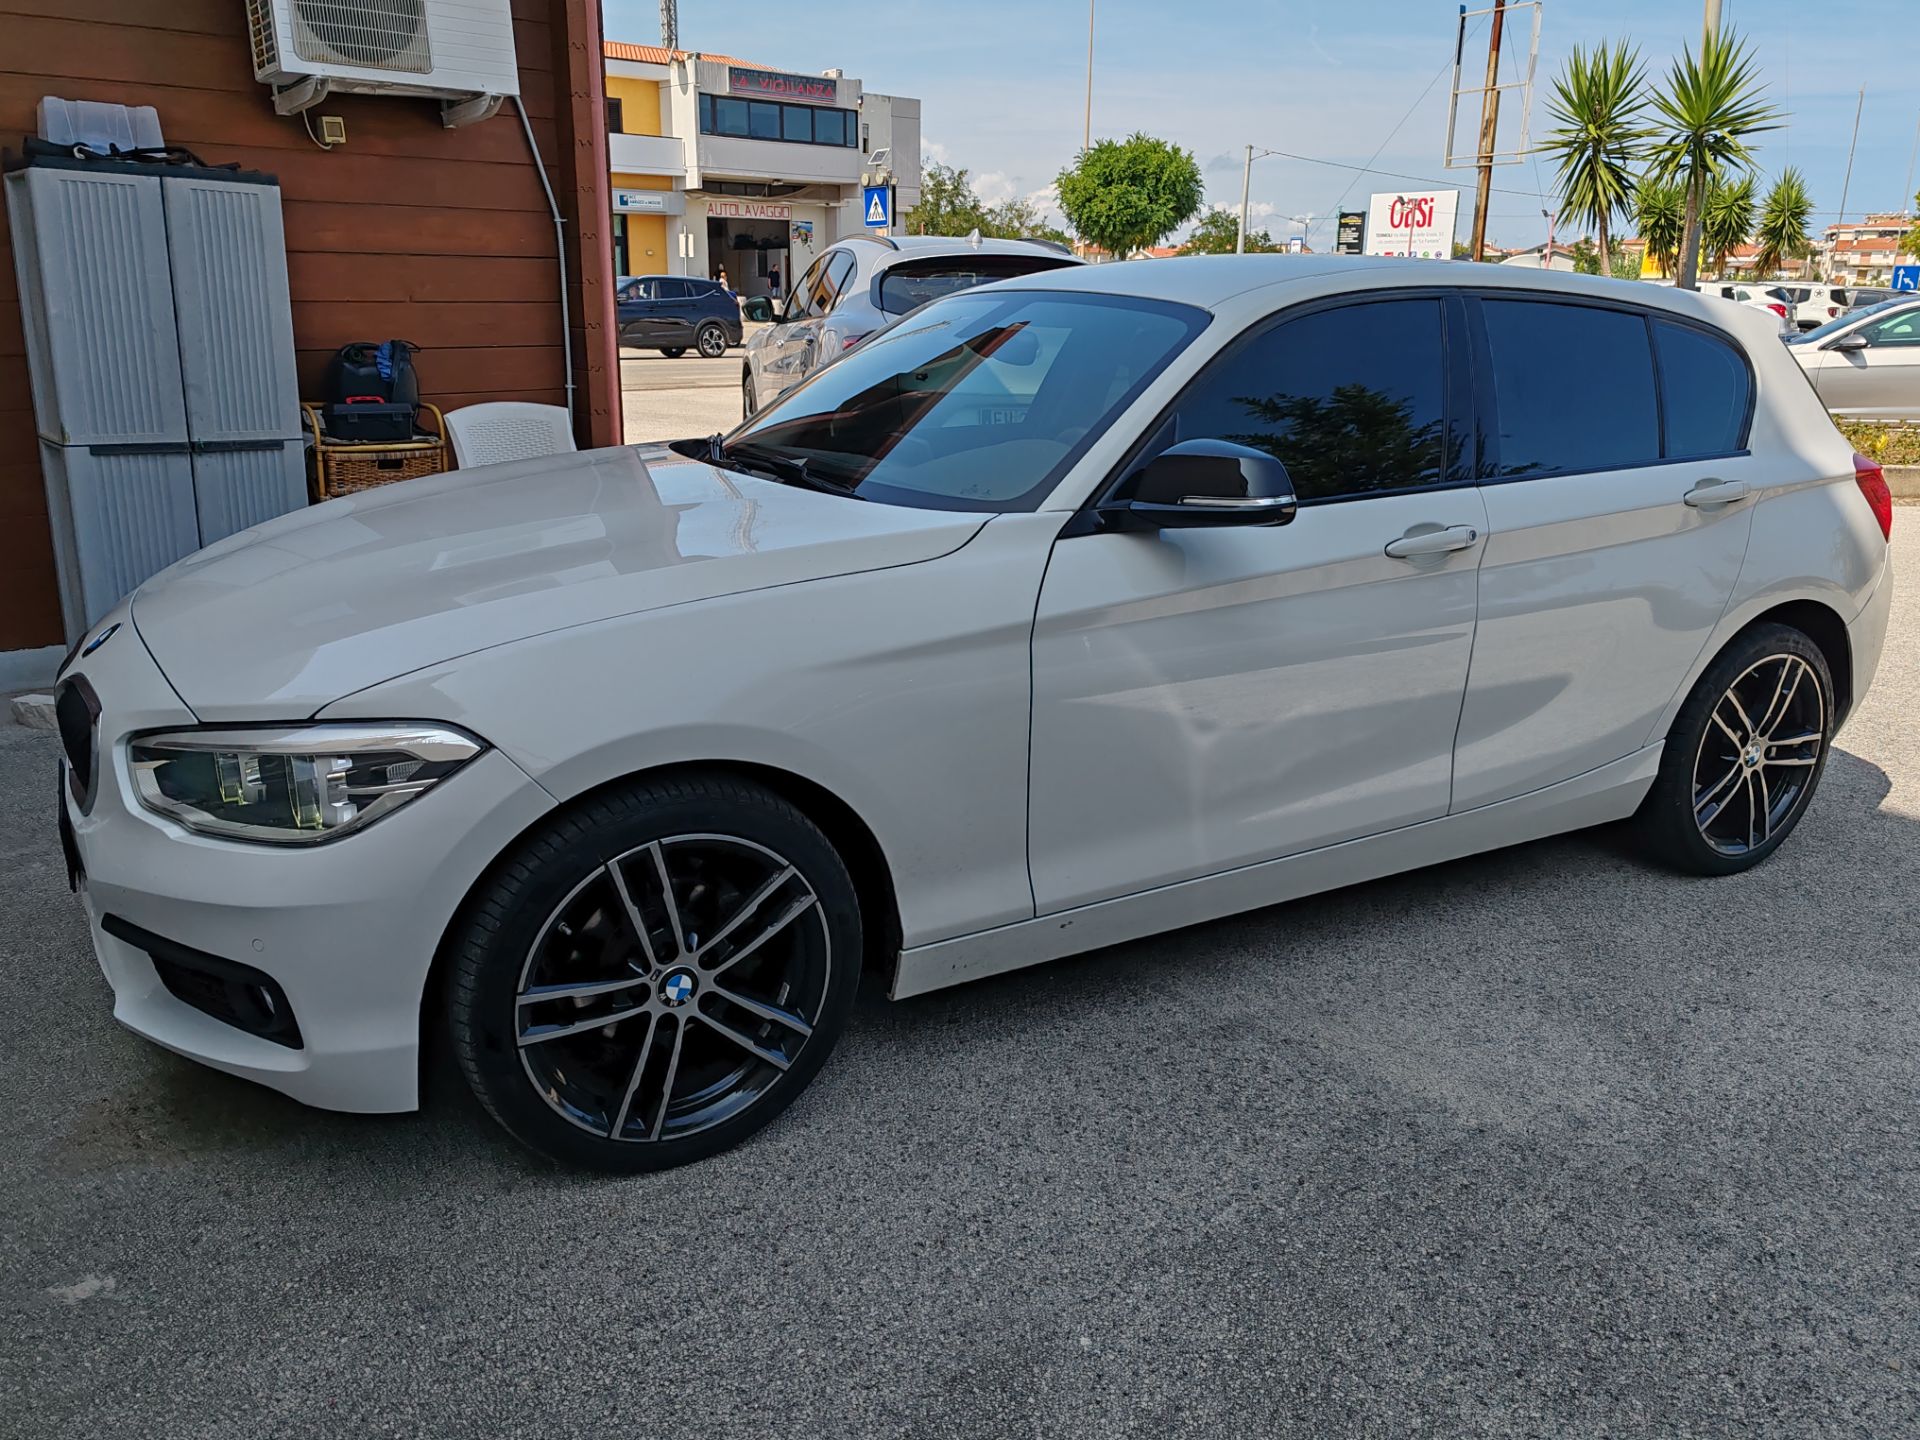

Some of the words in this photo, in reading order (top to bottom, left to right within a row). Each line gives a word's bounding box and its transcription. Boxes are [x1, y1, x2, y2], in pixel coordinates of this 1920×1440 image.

[732, 75, 748, 87] LA
[759, 79, 833, 97] VIGILANZA
[707, 202, 789, 218] AUTOLAVAGGIO
